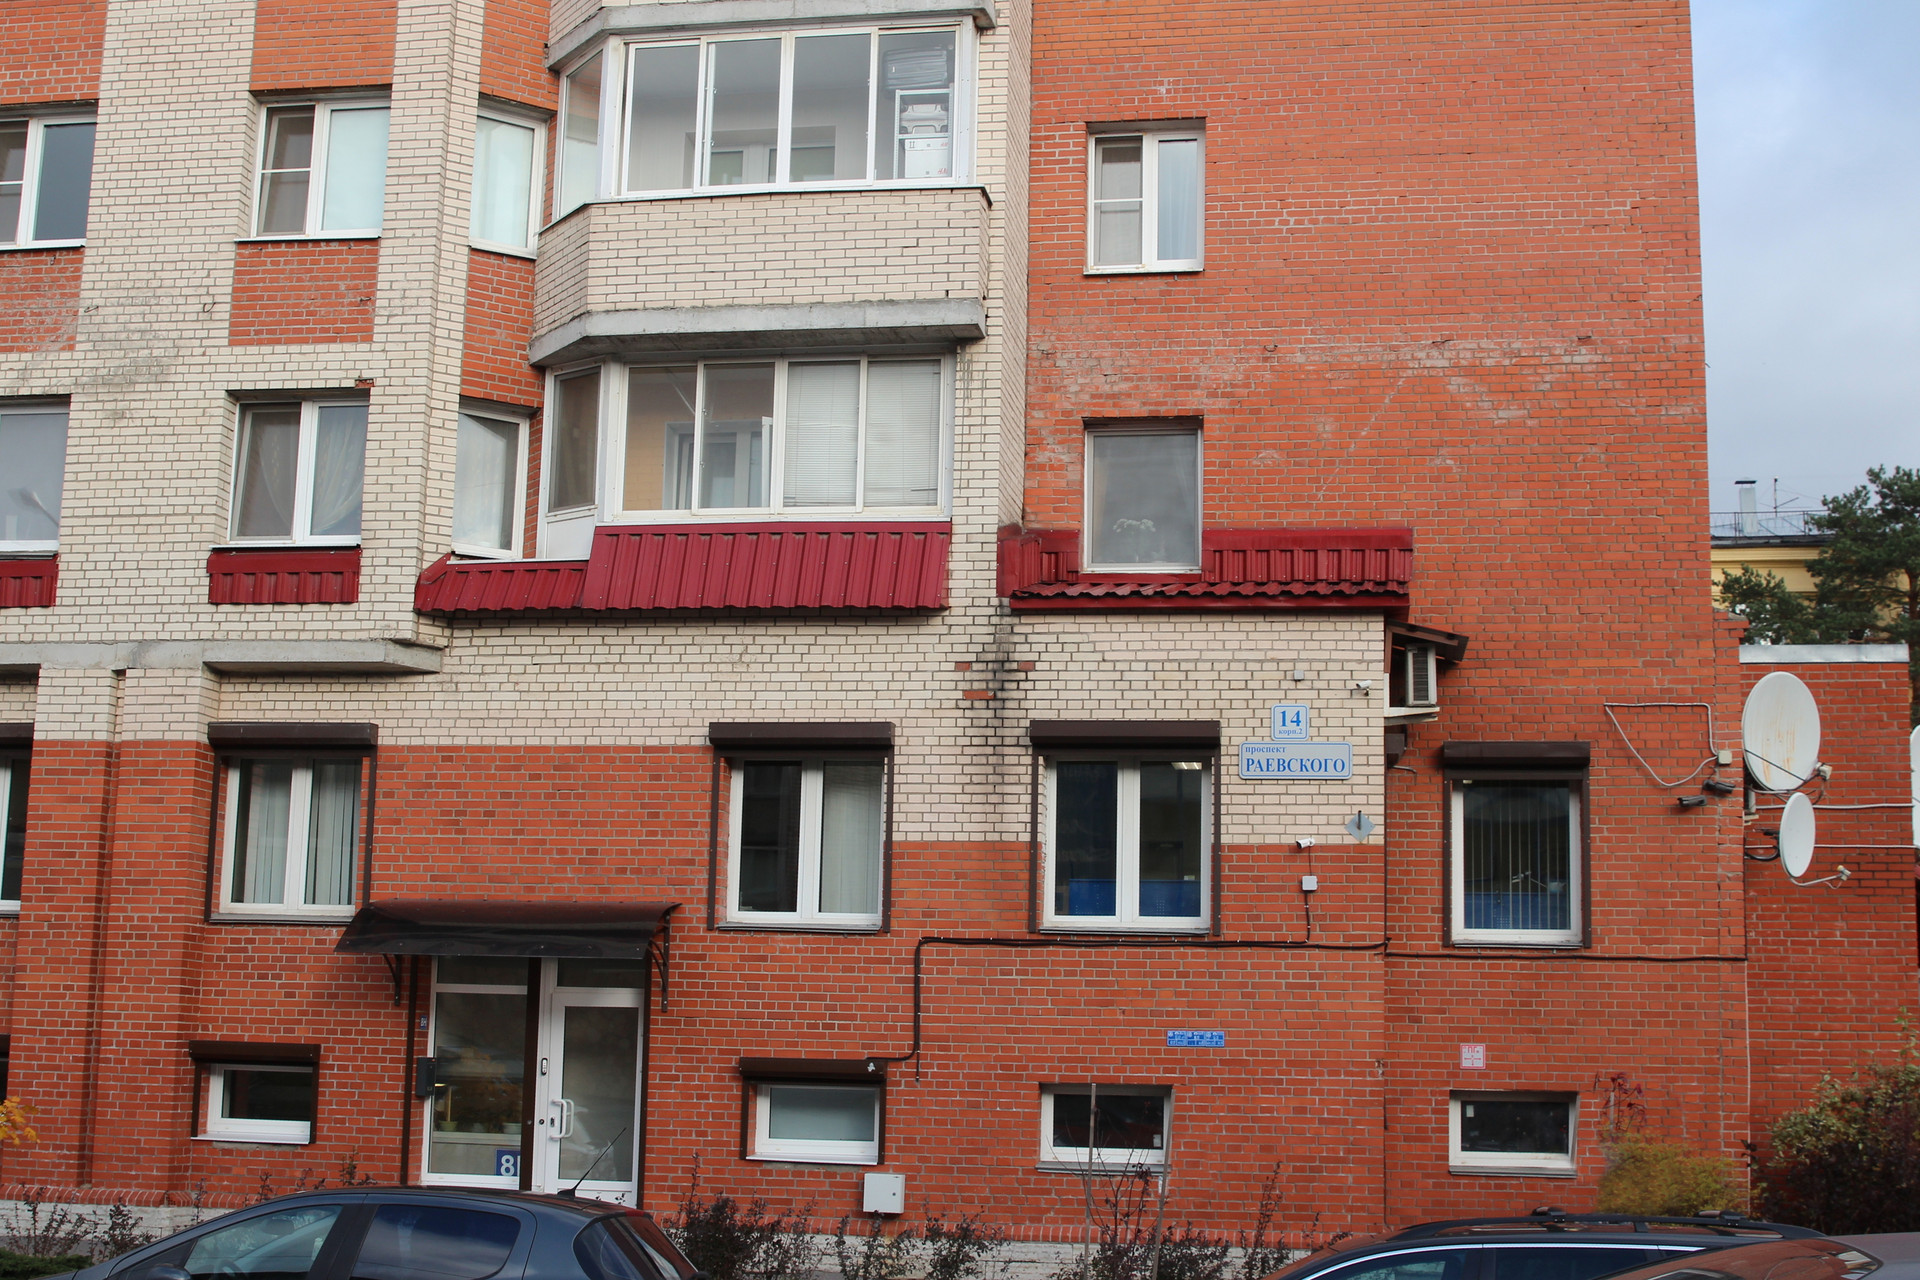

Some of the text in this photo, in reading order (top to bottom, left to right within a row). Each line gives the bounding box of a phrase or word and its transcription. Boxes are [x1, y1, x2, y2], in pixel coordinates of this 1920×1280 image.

[1280, 710, 1301, 727] 14
[1245, 746, 1286, 754] проспект
[1245, 758, 1345, 772] РАЕВСКОГО
[500, 1154, 520, 1176] 8
